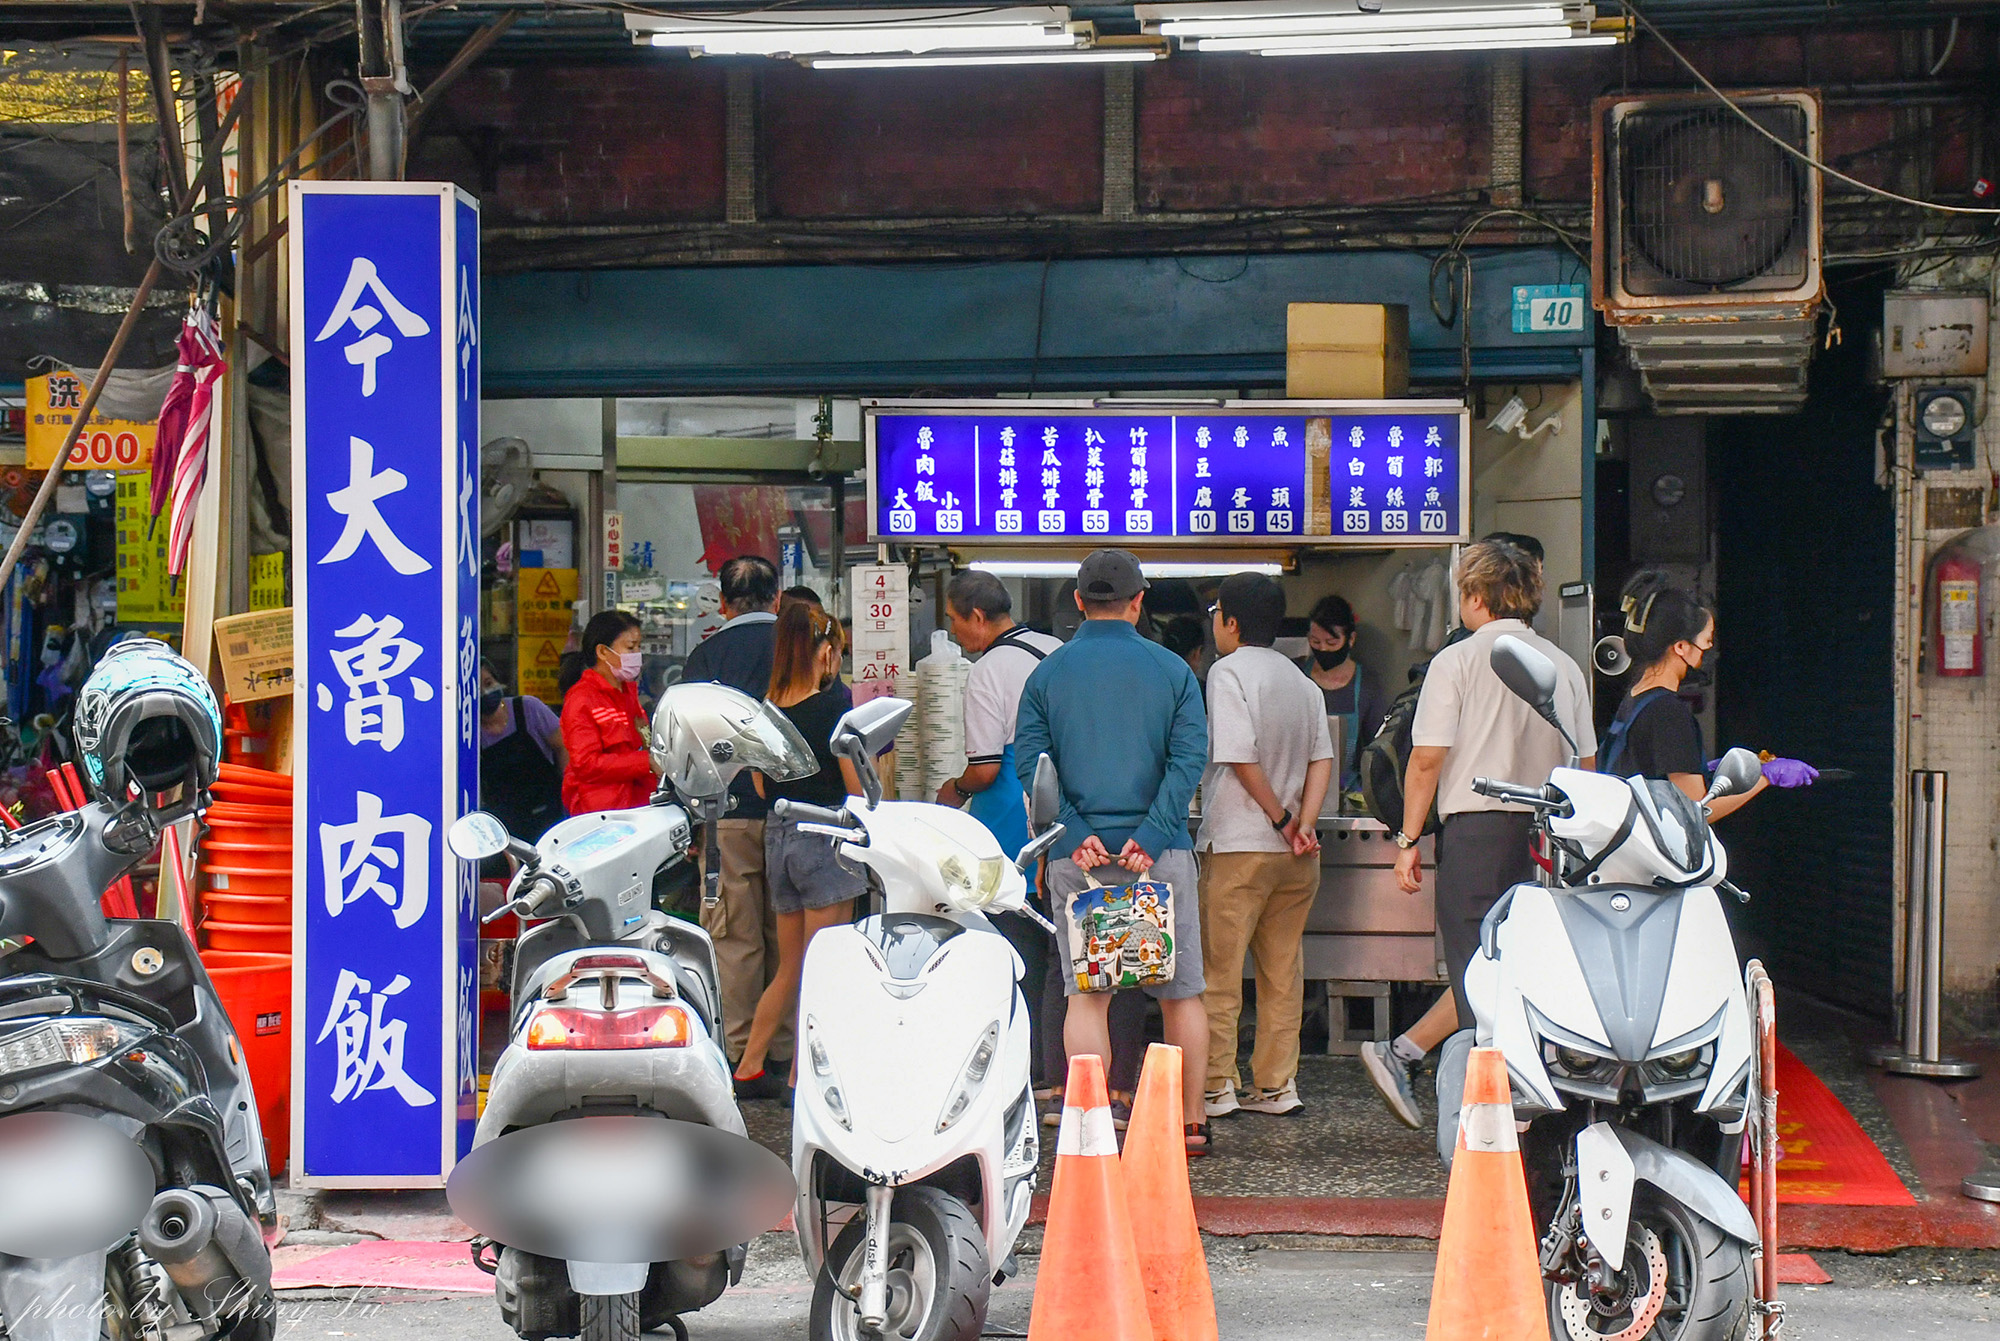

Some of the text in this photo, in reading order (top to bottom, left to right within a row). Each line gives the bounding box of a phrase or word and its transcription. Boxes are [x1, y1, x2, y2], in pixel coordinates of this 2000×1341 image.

[1543, 302, 1572, 326] 40
[67, 431, 139, 464] 500
[914, 426, 938, 503] 魯肉飯
[999, 426, 1018, 508] 香菇排骨
[1041, 426, 1062, 508] 苦瓜排骨
[1084, 427, 1106, 508] 扒菜排骨
[1129, 426, 1148, 508] 竹筍排骨
[1194, 426, 1212, 508] 魯豆腐
[1231, 425, 1252, 508] 魯蛋
[1270, 426, 1290, 508] 魚頭
[1348, 426, 1367, 508] 魯白菜
[1385, 425, 1405, 508] 魯筍絲
[1424, 426, 1444, 508] 吳郭魚
[893, 488, 912, 510] 大
[941, 491, 960, 510] 小
[892, 512, 913, 530] 50
[939, 512, 960, 530] 35
[998, 512, 1019, 530] 55
[1042, 512, 1062, 530] 55
[1085, 512, 1106, 530] 55
[1128, 512, 1150, 530] 55
[1193, 512, 1212, 530] 10
[1231, 512, 1250, 530] 15
[1269, 512, 1290, 530] 45
[1346, 512, 1367, 530] 35
[1384, 512, 1406, 530] 35
[1422, 512, 1444, 530] 70
[875, 575, 886, 588] 4
[870, 604, 892, 618] 30
[862, 663, 900, 680] 公休
[314, 257, 437, 1108] 今大魯肉飯
